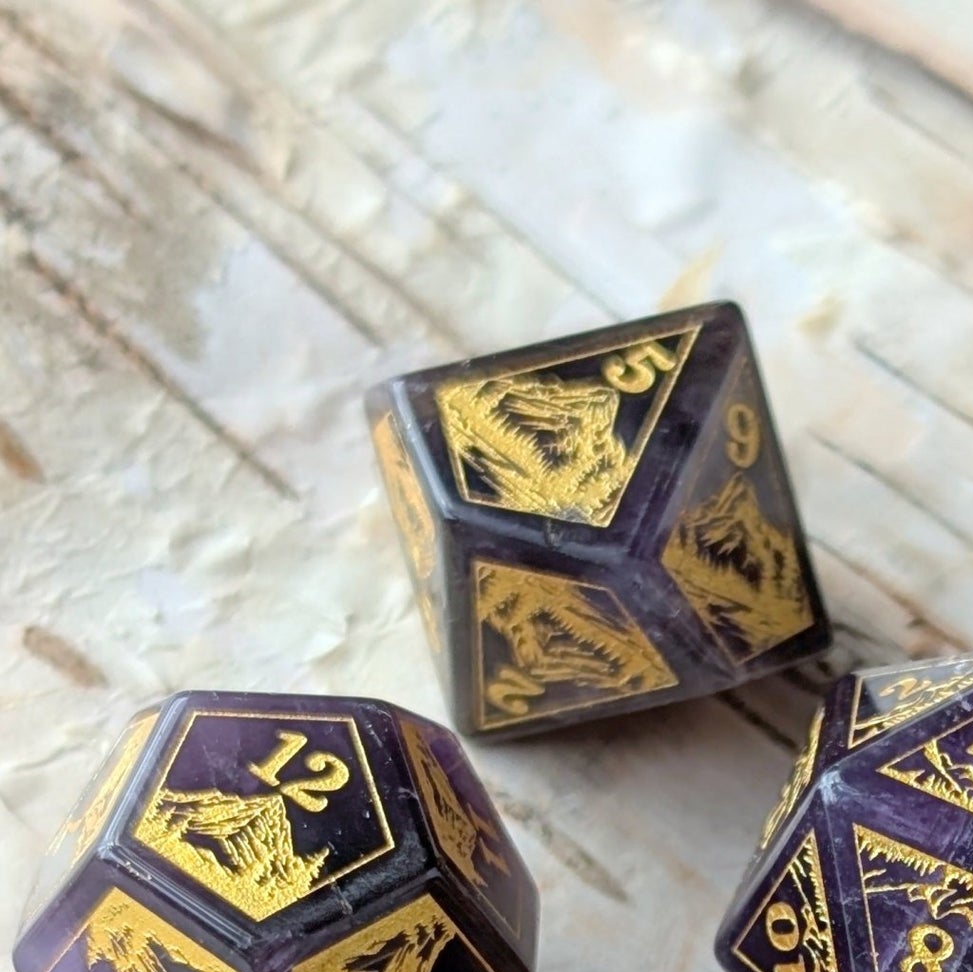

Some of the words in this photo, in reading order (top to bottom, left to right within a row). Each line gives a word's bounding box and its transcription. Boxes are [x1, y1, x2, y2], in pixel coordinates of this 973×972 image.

[603, 341, 678, 394] 5
[488, 668, 545, 714] 2
[248, 729, 350, 813] 12
